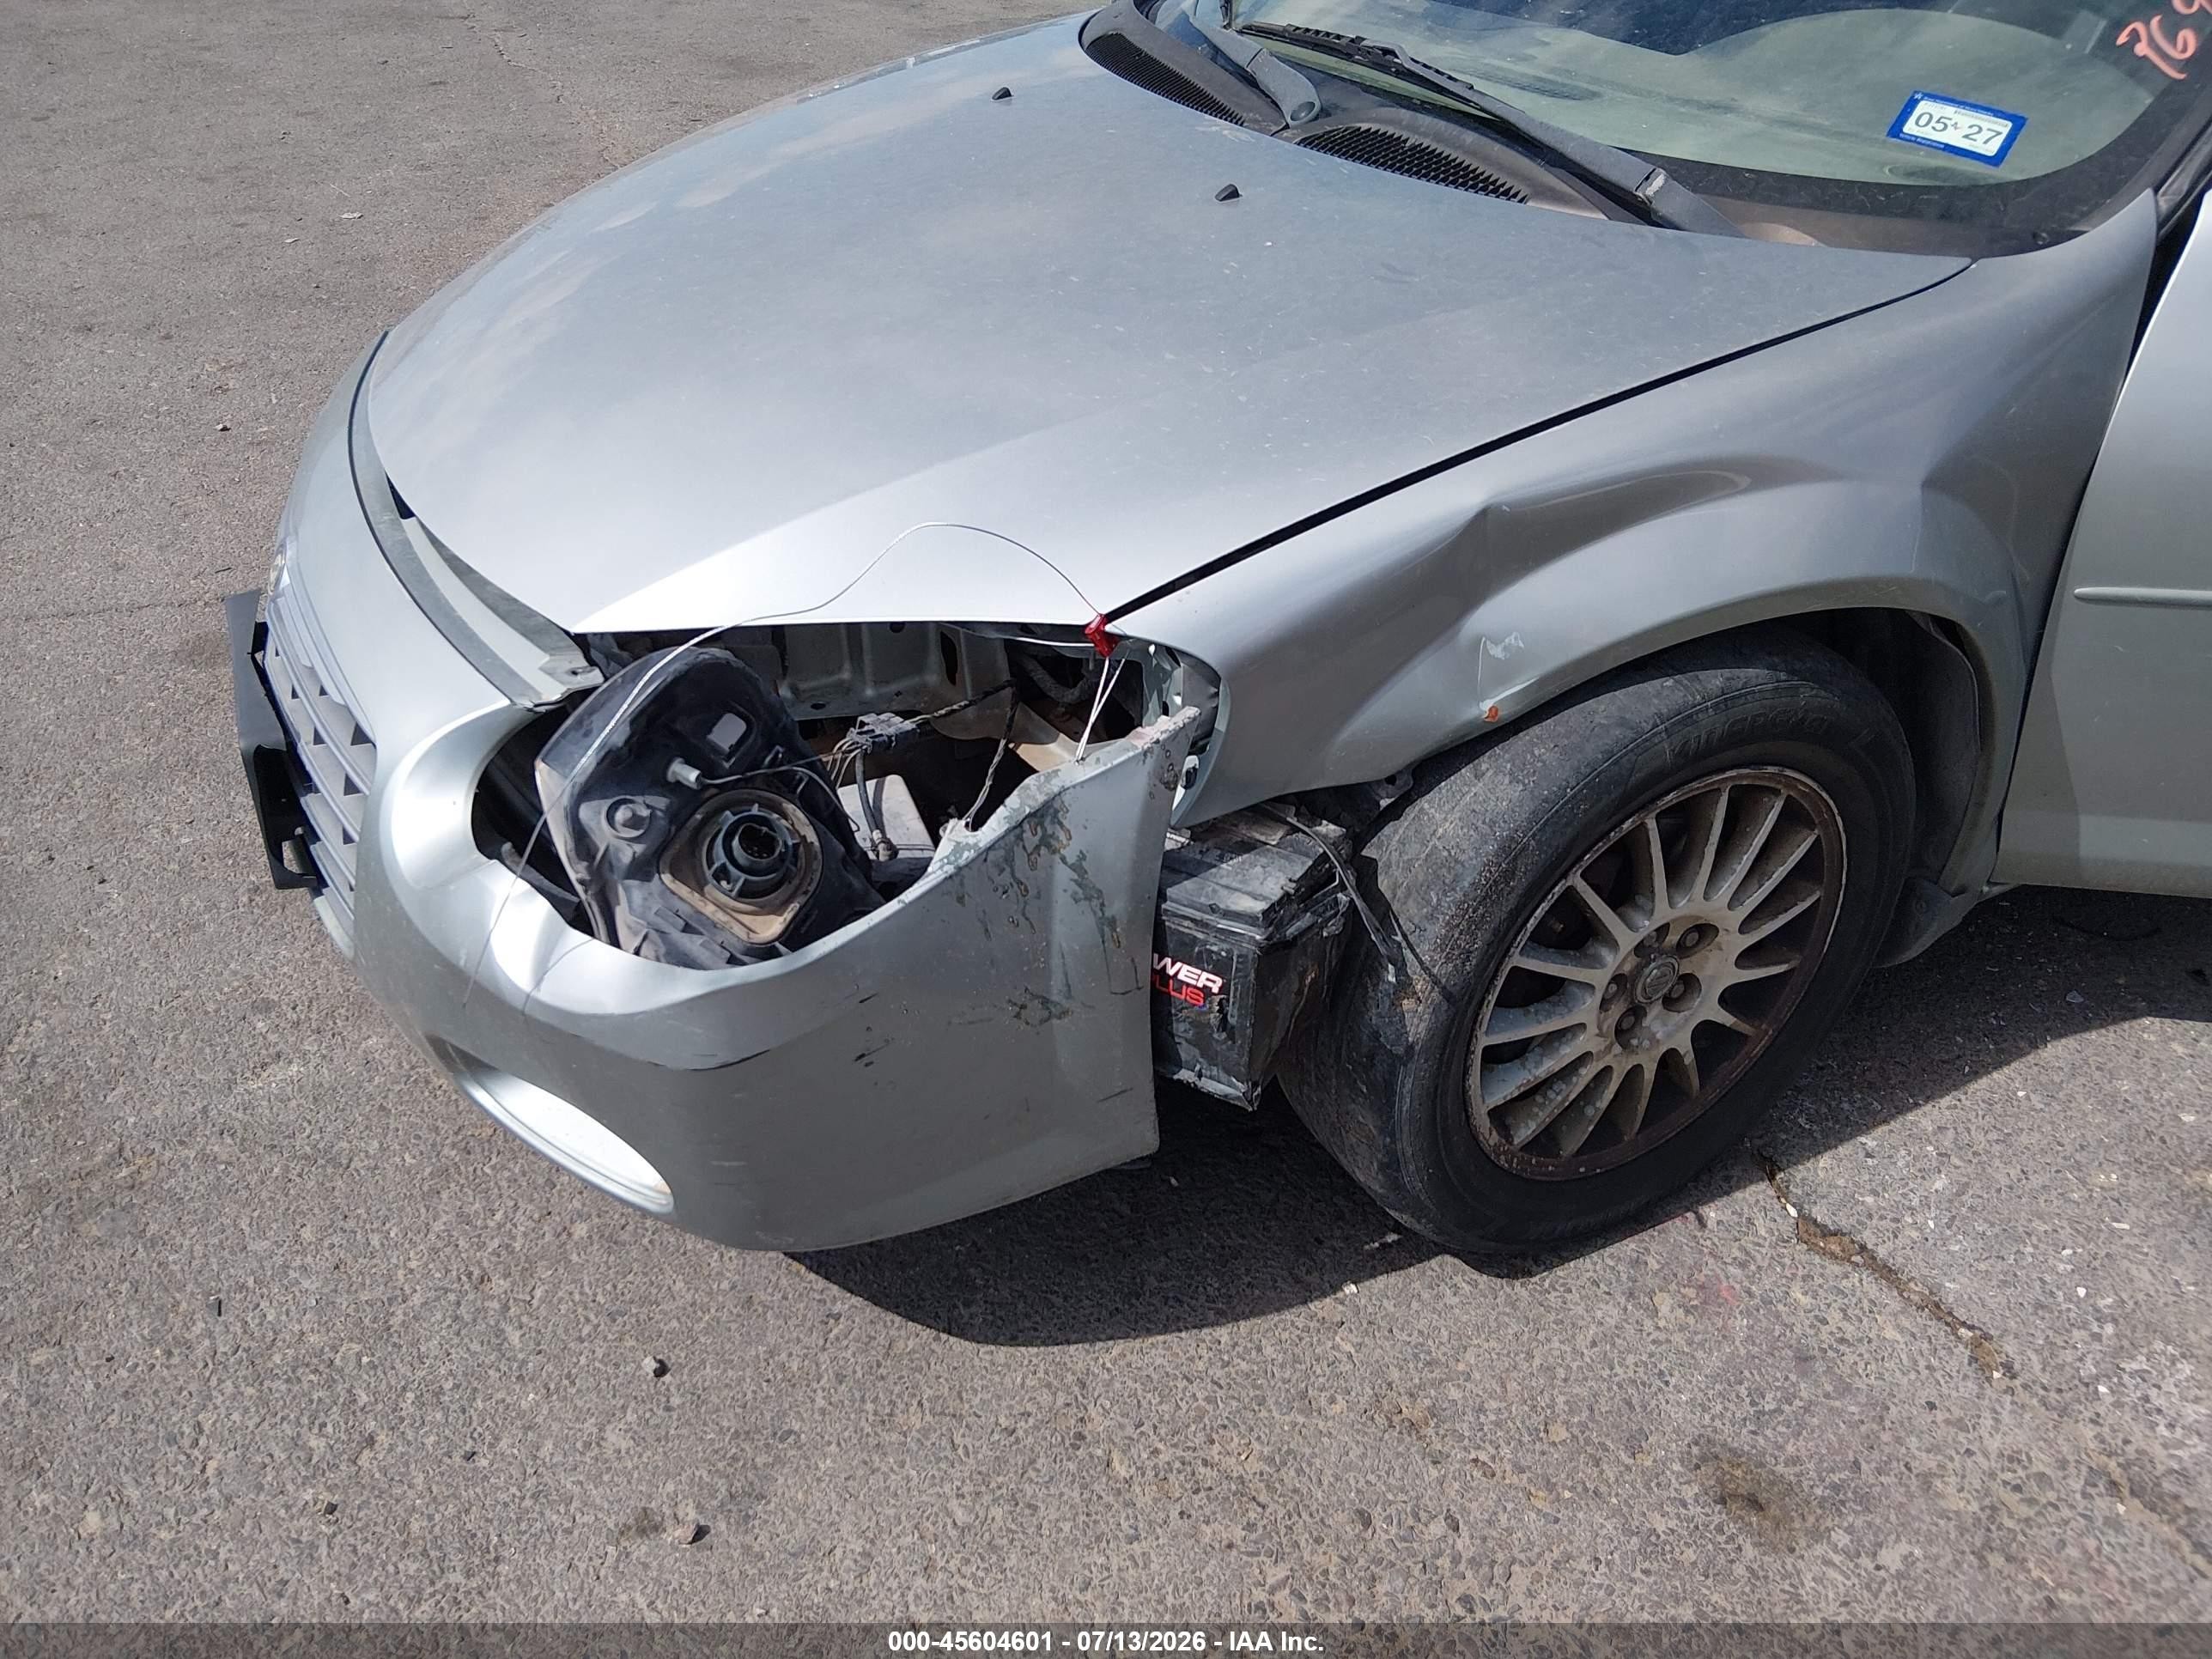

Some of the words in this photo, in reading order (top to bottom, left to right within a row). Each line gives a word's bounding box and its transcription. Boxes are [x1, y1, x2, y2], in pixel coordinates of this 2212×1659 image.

[1915, 111, 1953, 133] 05
[1962, 124, 2003, 145] 27
[1152, 953, 1223, 994] WER
[1154, 976, 1205, 1006] LUS
